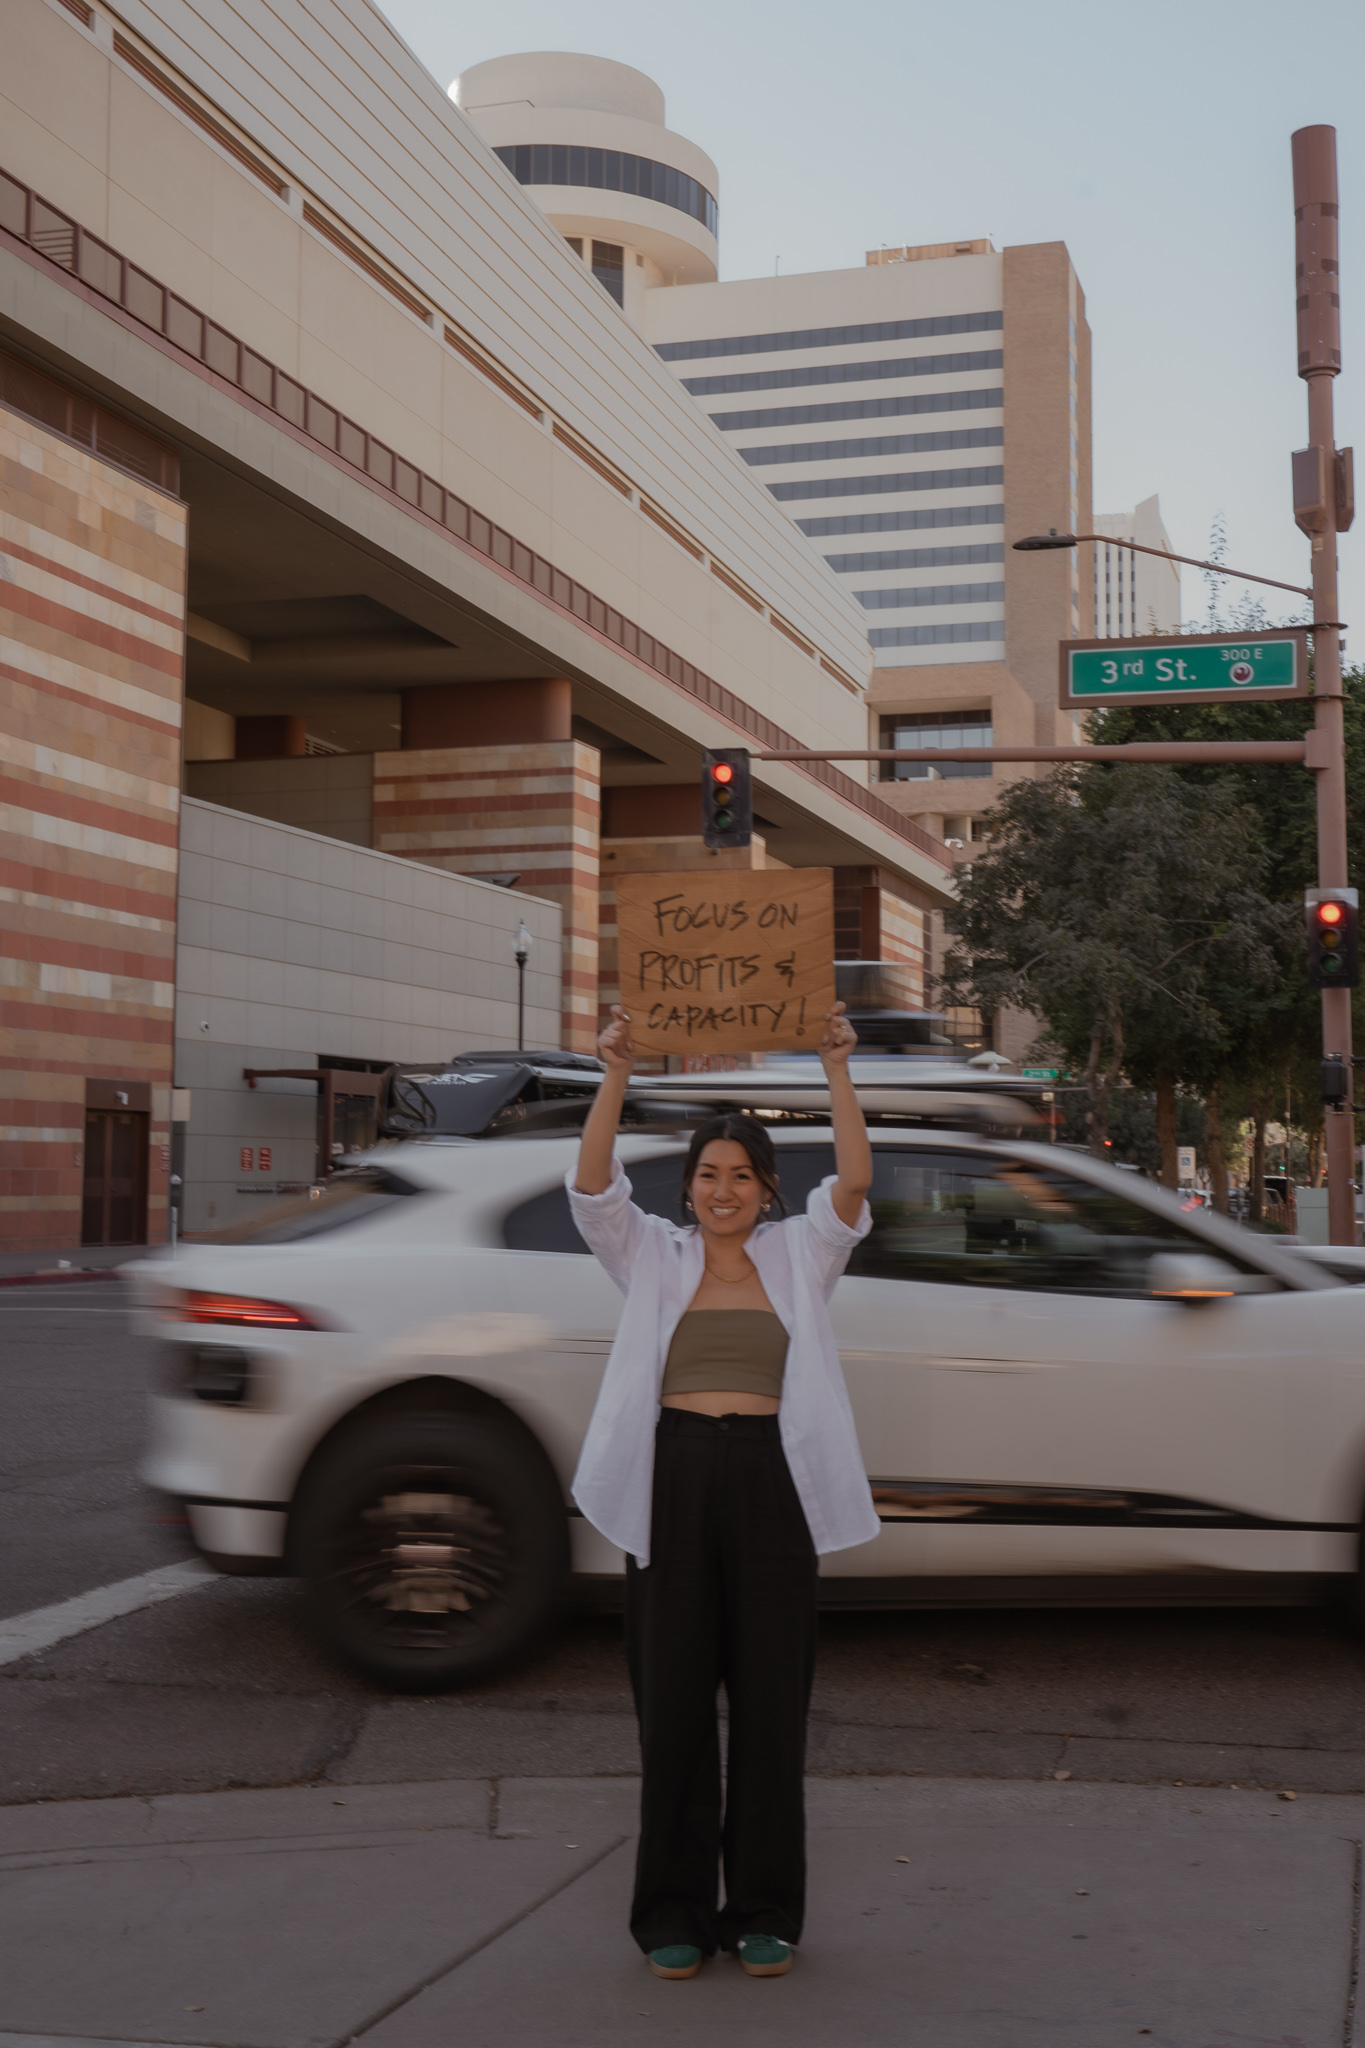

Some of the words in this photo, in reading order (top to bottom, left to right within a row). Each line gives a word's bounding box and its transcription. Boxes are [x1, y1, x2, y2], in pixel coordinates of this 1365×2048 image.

[1101, 659, 1143, 684] 3rd
[1155, 658, 1197, 682] St.
[1220, 649, 1250, 661] 300
[1254, 648, 1263, 659] E
[653, 894, 748, 937] FOCUS
[758, 902, 798, 929] ON
[639, 951, 761, 992] PROFITS
